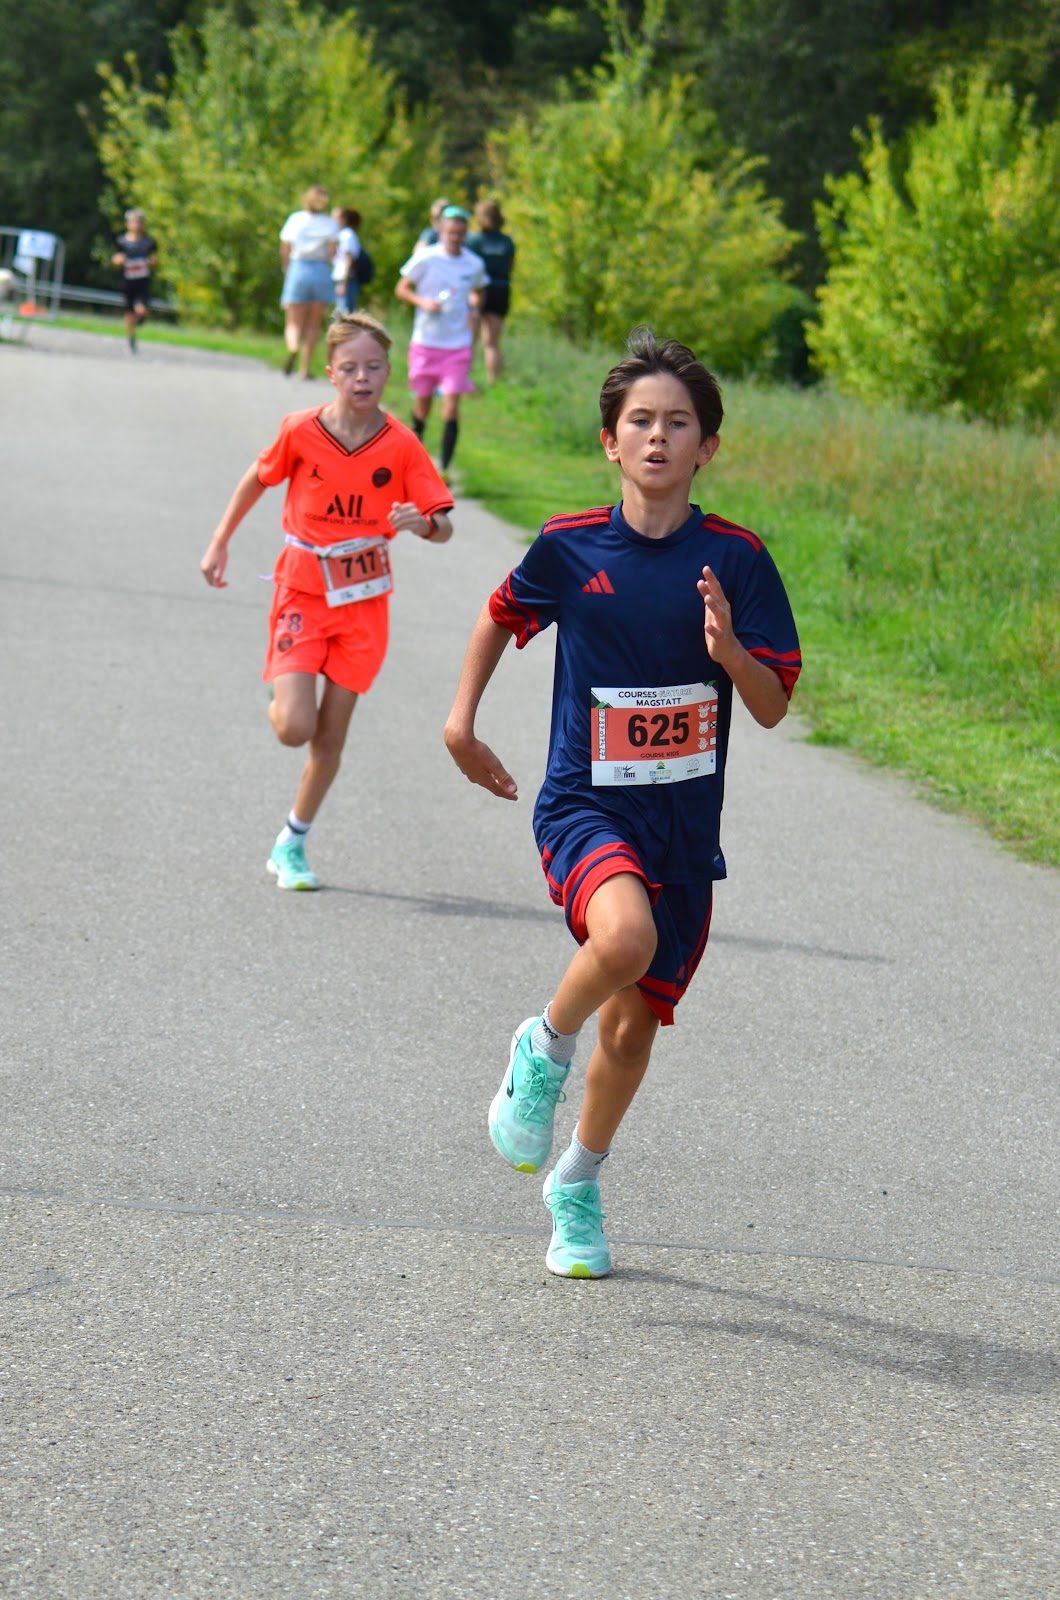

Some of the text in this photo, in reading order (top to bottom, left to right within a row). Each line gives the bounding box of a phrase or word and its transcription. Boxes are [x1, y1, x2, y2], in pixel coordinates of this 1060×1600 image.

[340, 550, 376, 578] 717
[636, 697, 682, 707] MAGSTATT
[659, 687, 693, 698] NATURE
[628, 711, 690, 747] 625
